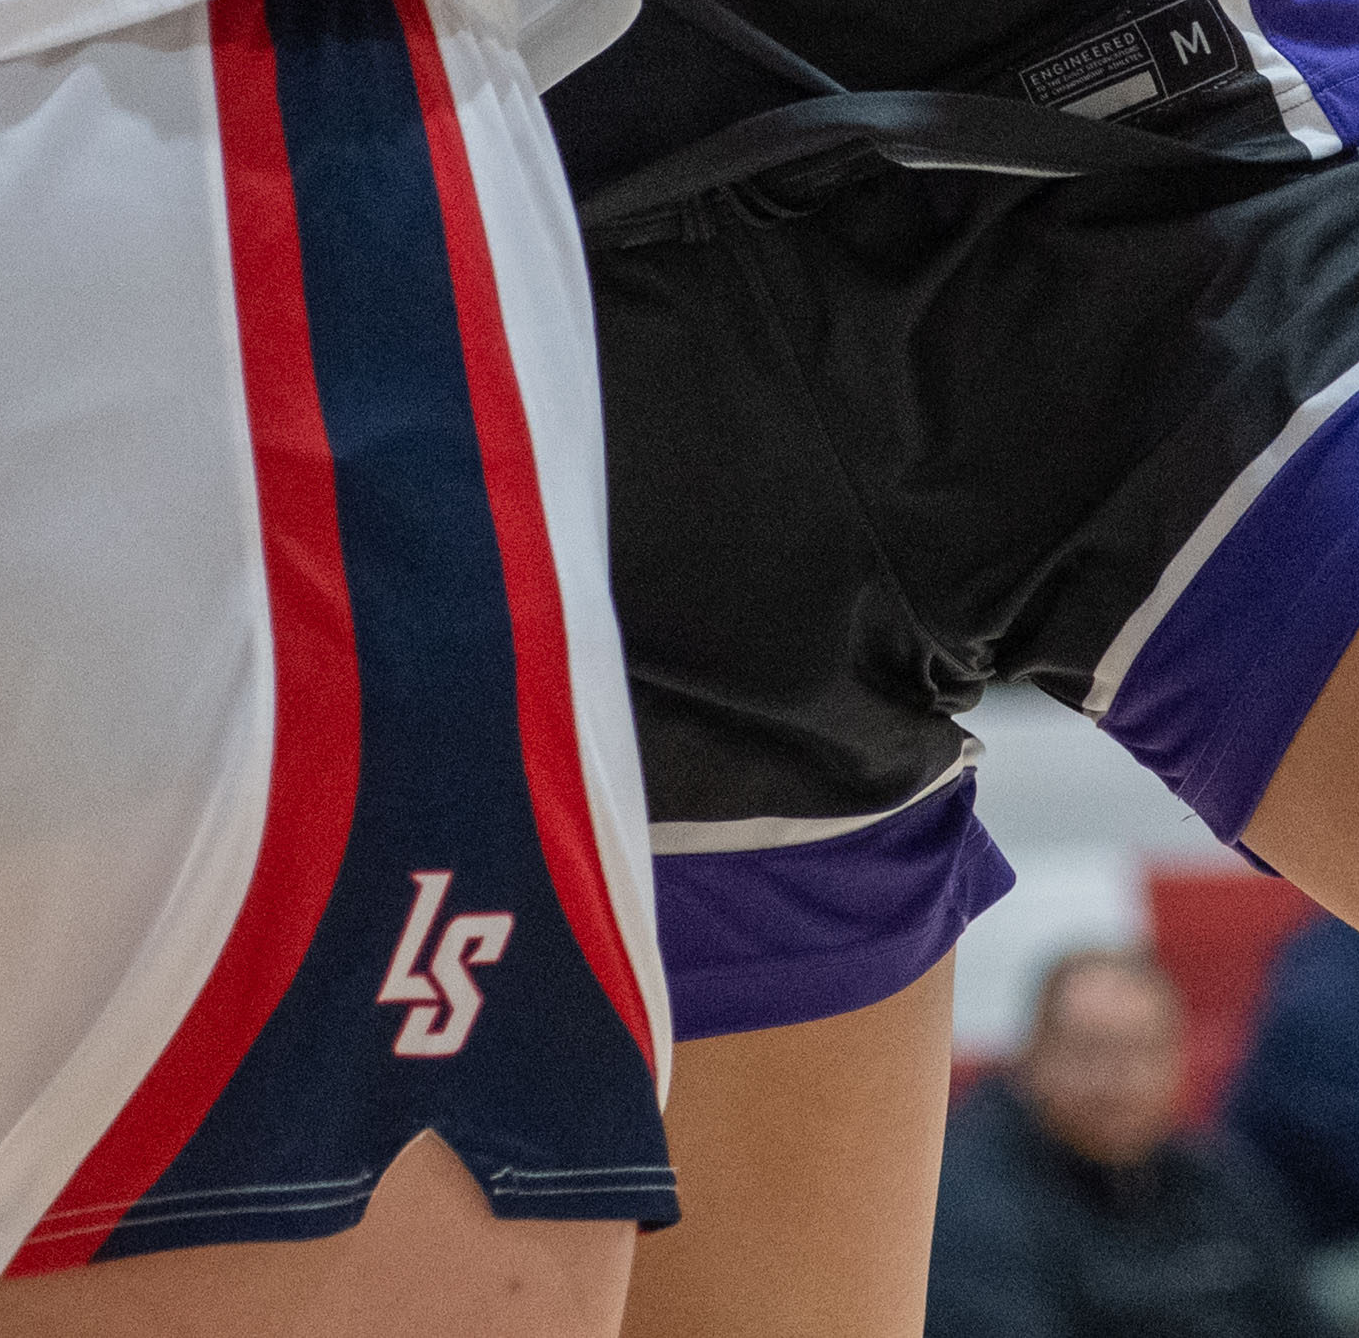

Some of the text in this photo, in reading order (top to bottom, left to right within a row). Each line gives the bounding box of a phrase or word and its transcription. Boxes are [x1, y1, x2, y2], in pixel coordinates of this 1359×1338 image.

[1030, 32, 1136, 86] ENGINEERED
[1170, 21, 1212, 65] M
[375, 869, 516, 1060] LS
